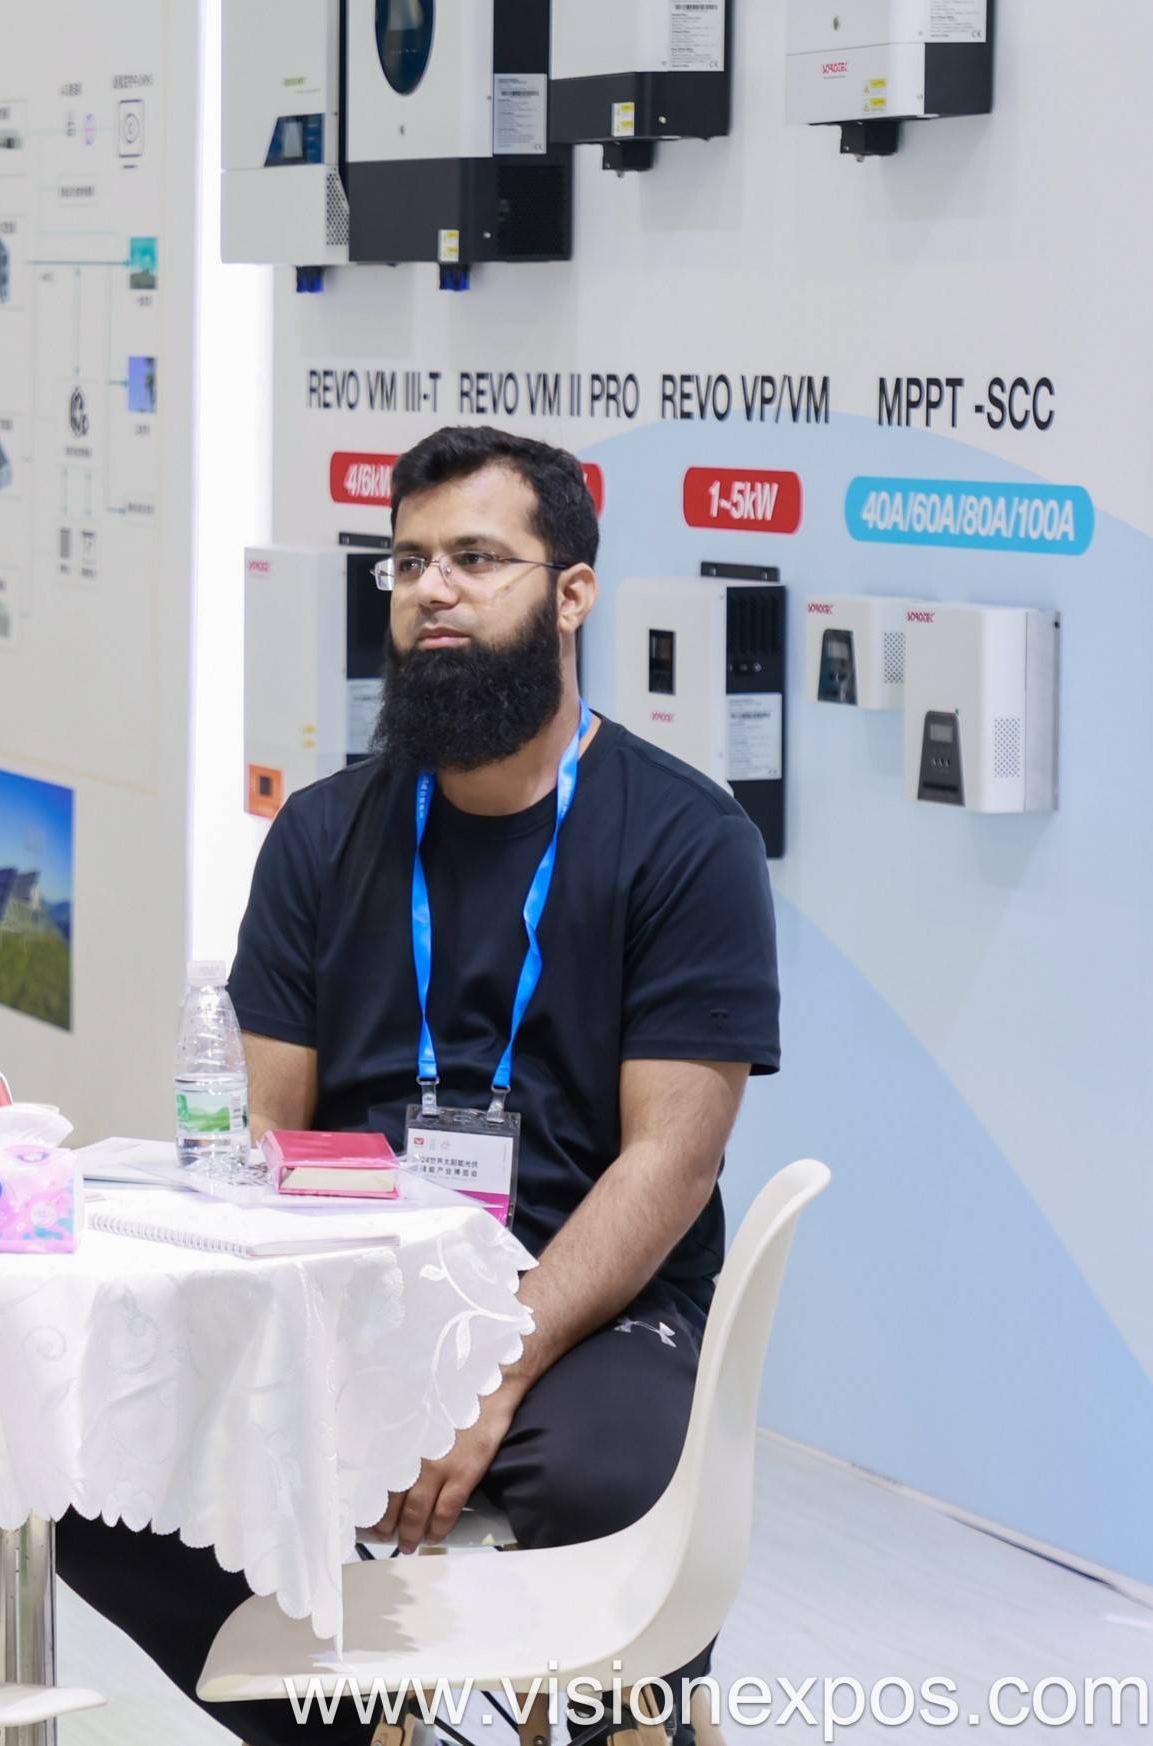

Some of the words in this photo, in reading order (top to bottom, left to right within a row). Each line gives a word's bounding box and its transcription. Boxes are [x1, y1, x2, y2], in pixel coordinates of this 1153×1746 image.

[307, 369, 360, 411] REVO
[366, 370, 397, 412] VM
[404, 371, 443, 413] III-T
[459, 371, 520, 415] REVO
[526, 373, 561, 417] VM
[569, 374, 582, 418] II
[590, 374, 640, 419] PRO
[661, 373, 732, 422] REVO
[740, 375, 830, 424] VP/VM
[877, 377, 964, 428] MPPT
[974, 376, 1056, 431] -SCC
[861, 488, 1075, 542] 40A/60A/80A/100A
